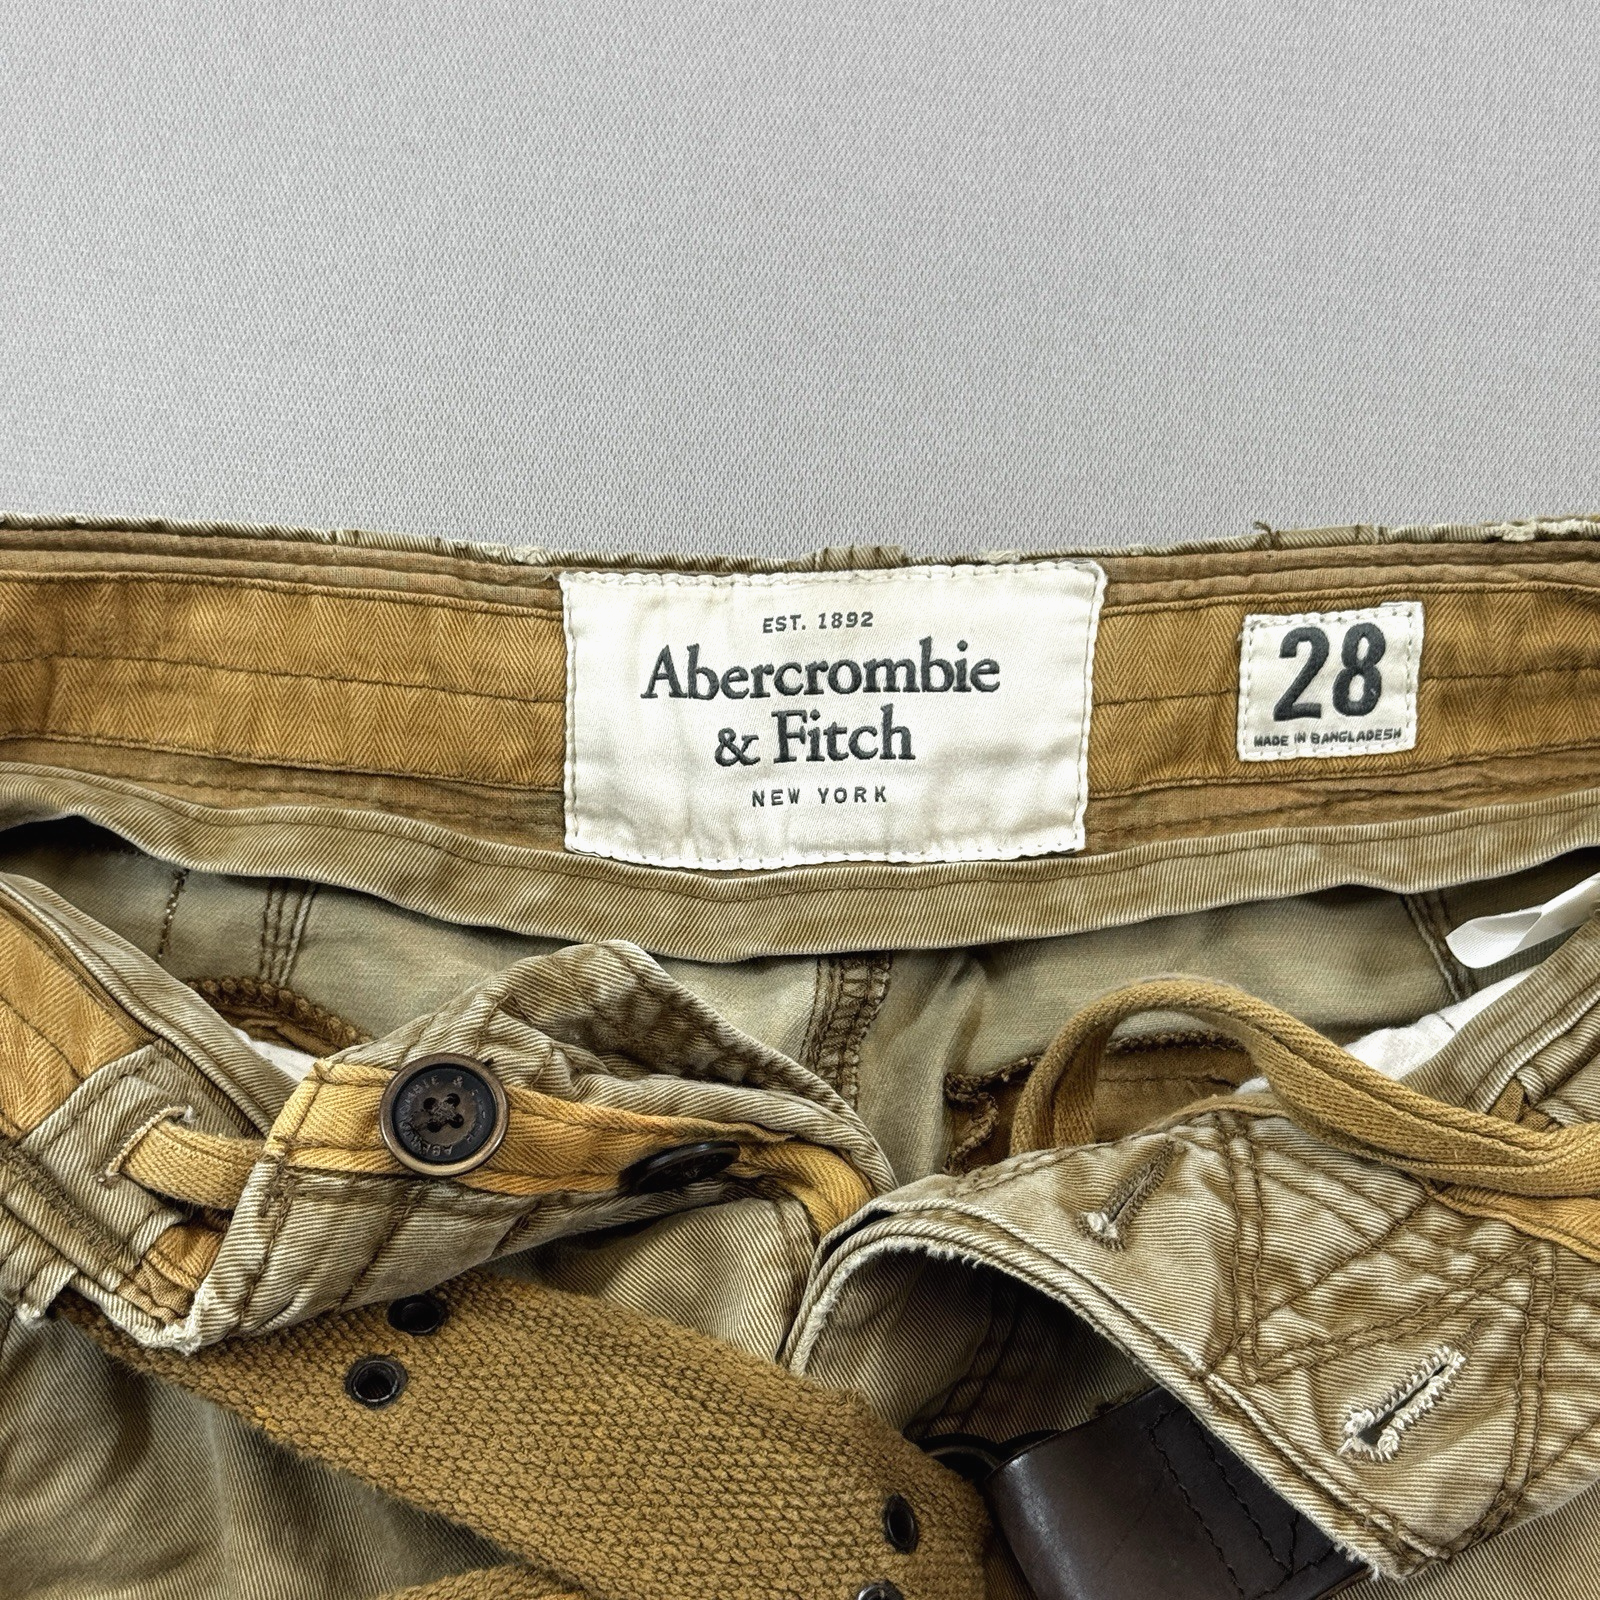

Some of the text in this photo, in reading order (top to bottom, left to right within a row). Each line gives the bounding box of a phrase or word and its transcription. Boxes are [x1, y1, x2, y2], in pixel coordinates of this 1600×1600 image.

[762, 611, 874, 633] EST. 1892
[641, 636, 1000, 700] Abercrombie
[1274, 622, 1386, 721] 28
[714, 703, 915, 767] & Fitch
[1254, 728, 1402, 747] MADE IN BANGLADESH
[752, 786, 888, 807] NEW YORK
